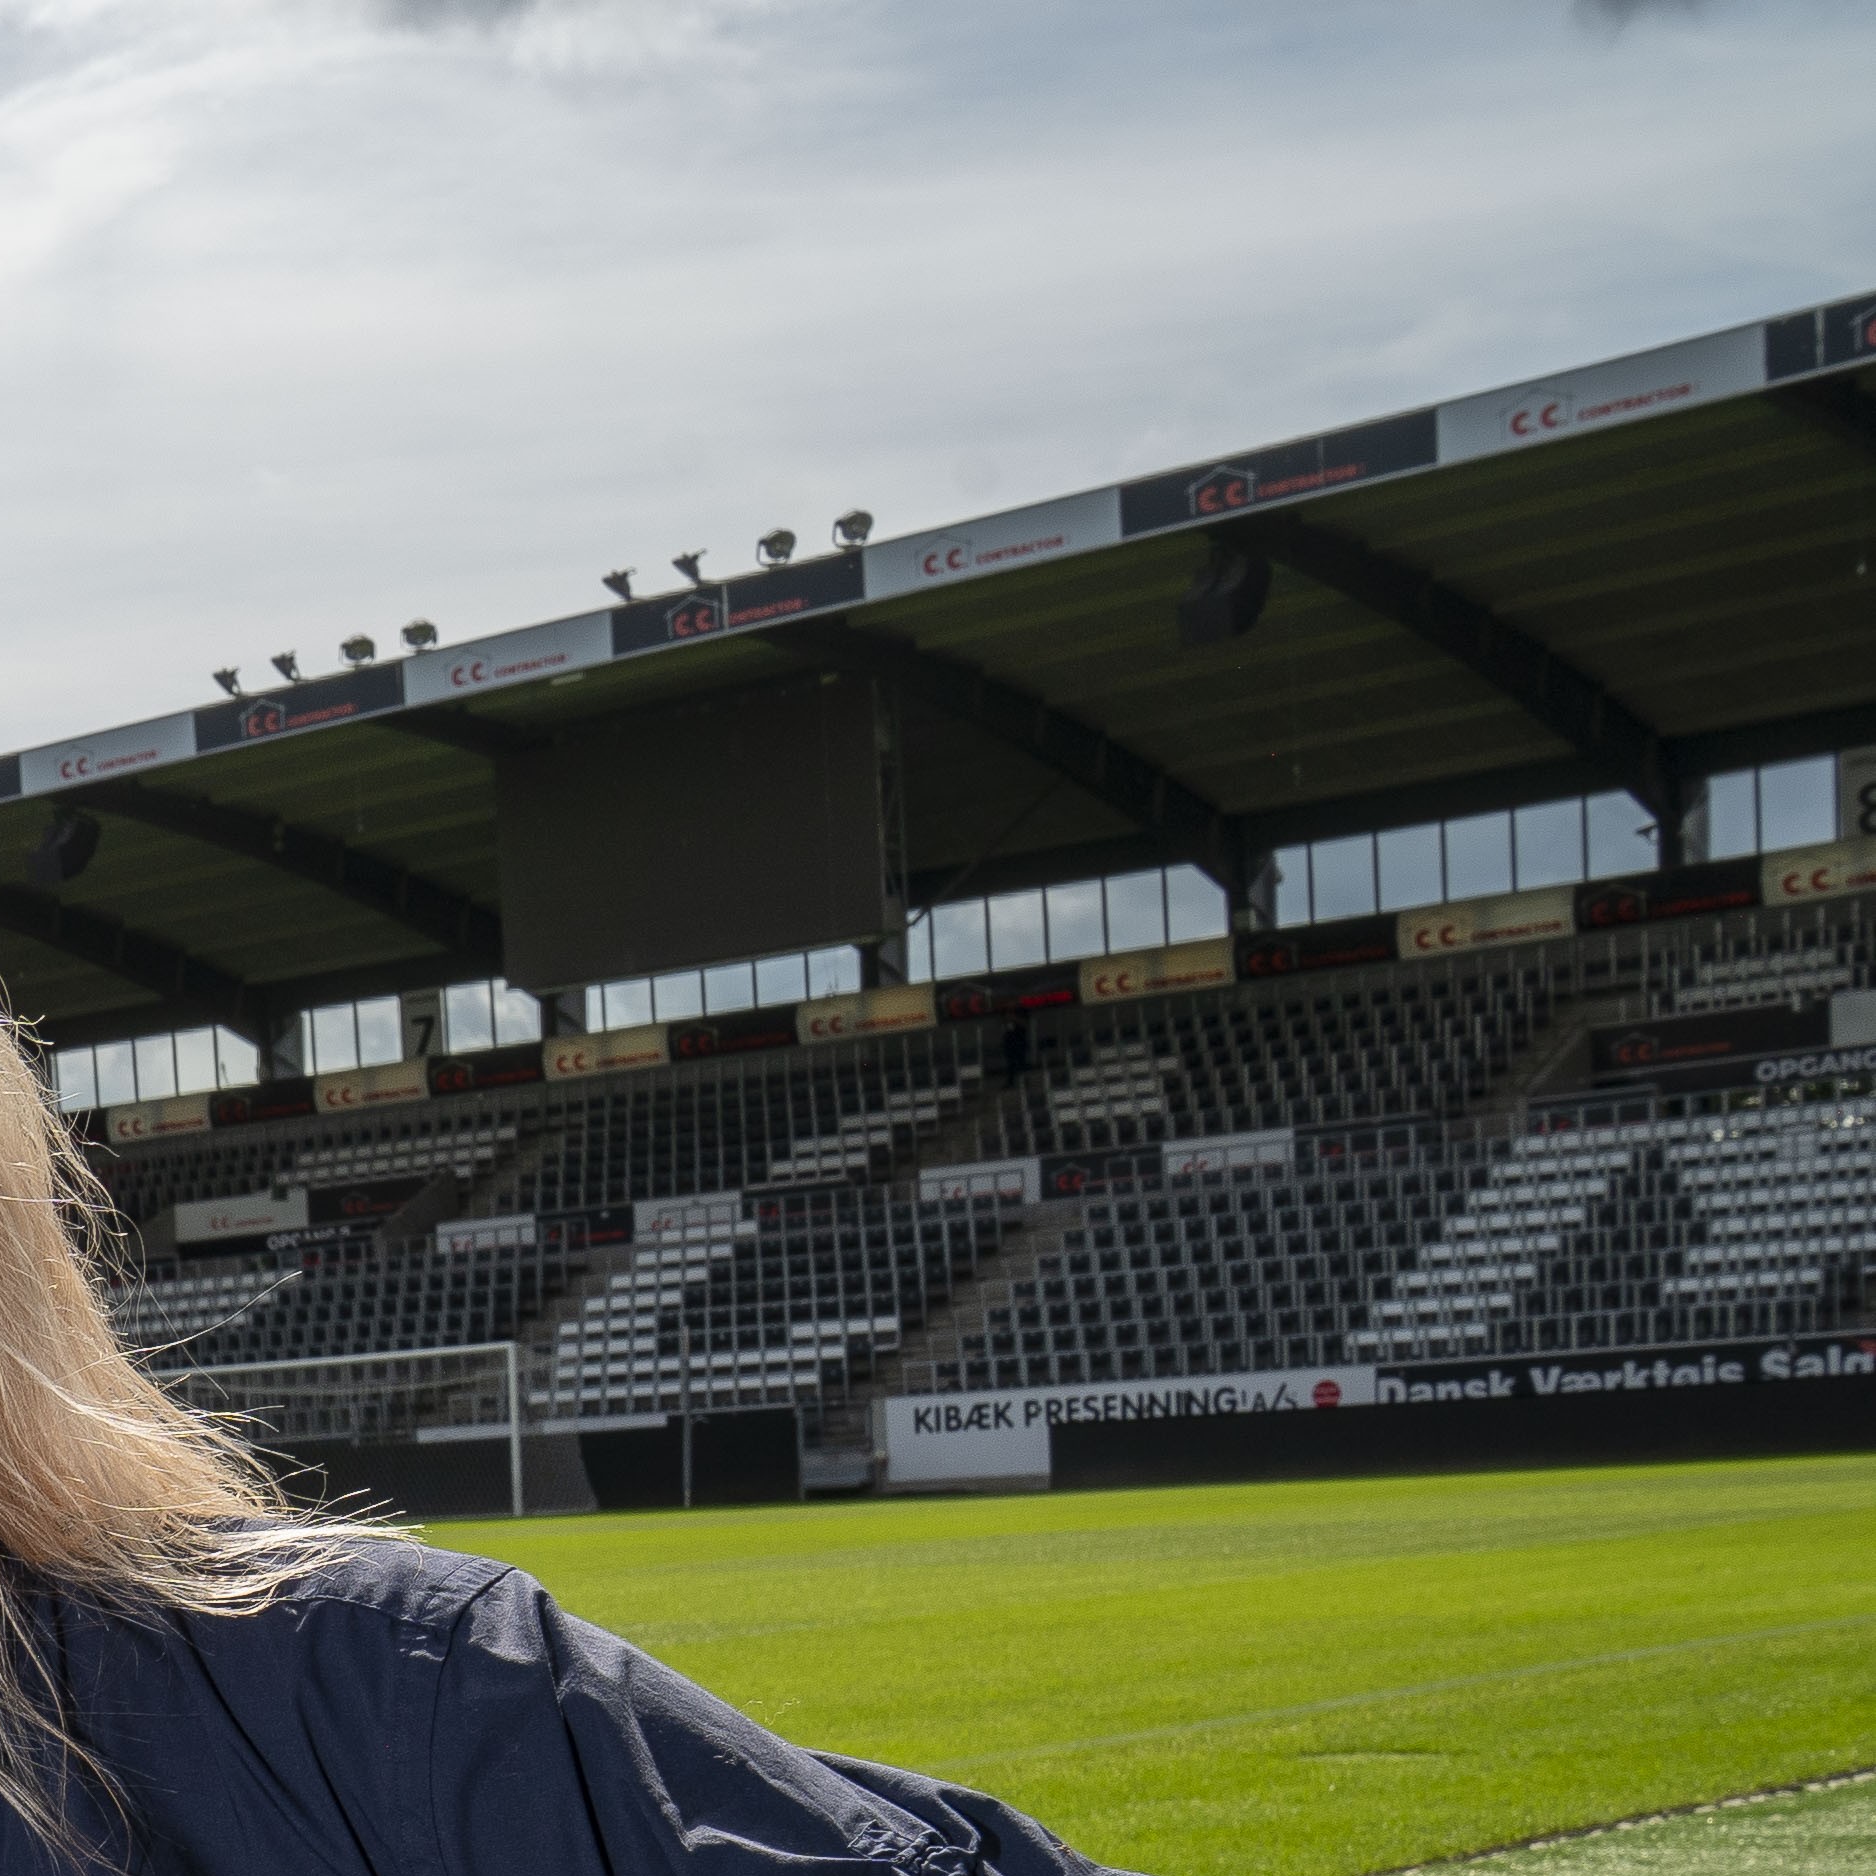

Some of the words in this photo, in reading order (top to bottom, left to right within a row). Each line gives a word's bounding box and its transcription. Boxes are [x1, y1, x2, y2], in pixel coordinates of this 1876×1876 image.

[411, 1015, 435, 1055] 7
[913, 1401, 1015, 1435] KIBÆK
[1024, 1386, 1237, 1428] PRESENNING
